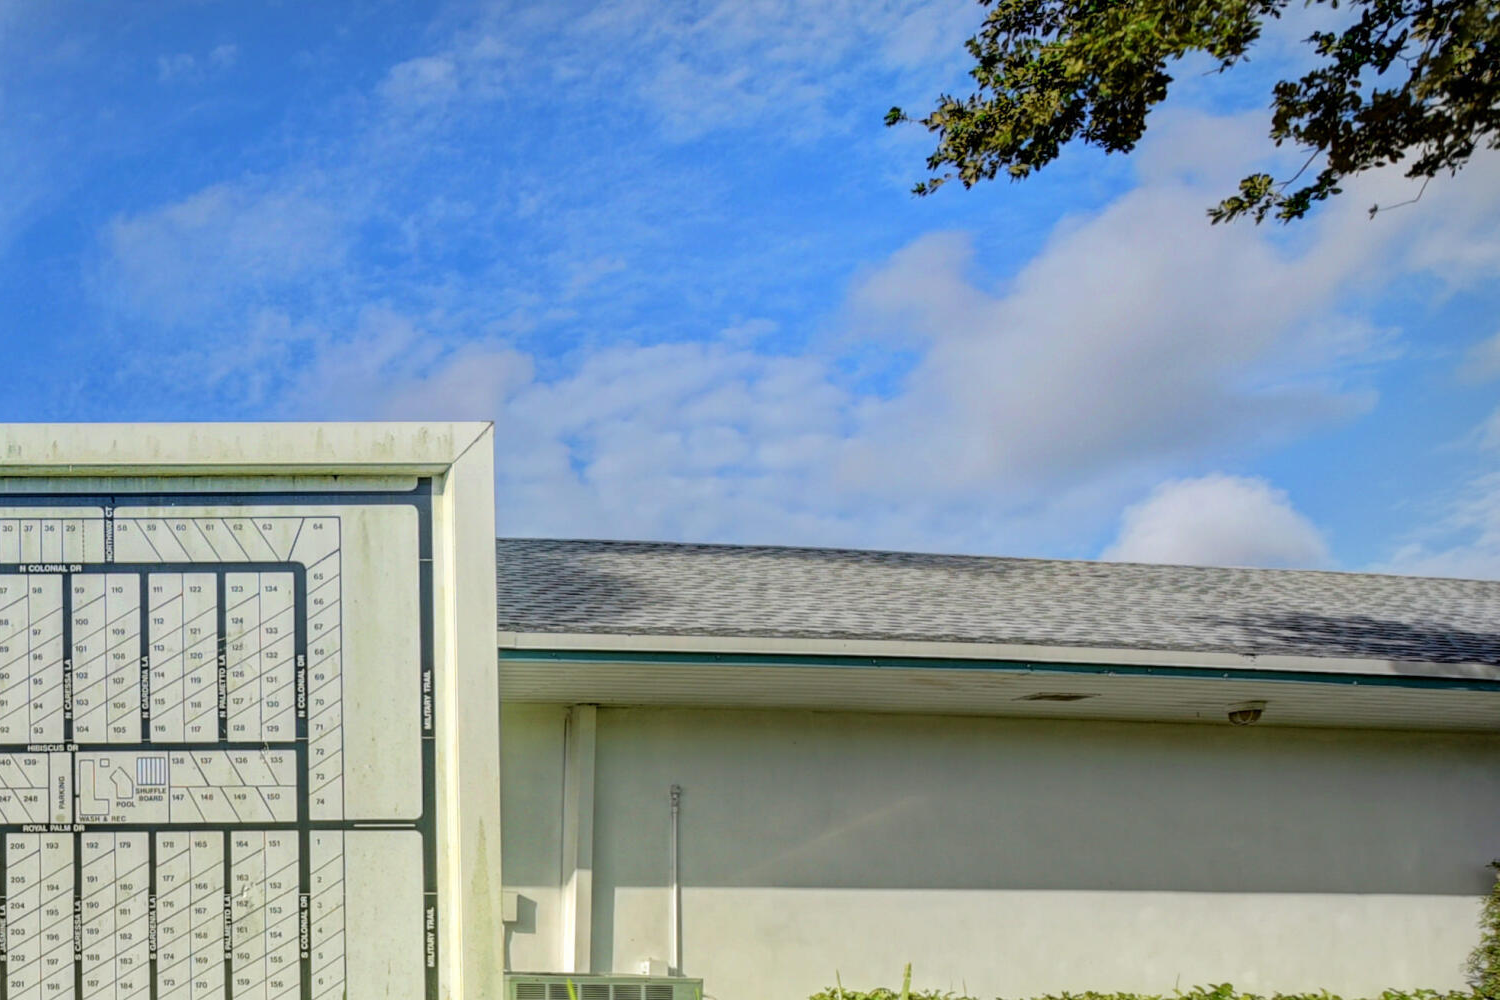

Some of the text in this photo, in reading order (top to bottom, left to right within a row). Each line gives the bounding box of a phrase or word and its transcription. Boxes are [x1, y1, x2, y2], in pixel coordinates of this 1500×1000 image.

[105, 506, 113, 518] CT
[28, 564, 68, 572] COLONIAL
[70, 564, 82, 572] DR
[75, 618, 88, 626] 100
[75, 645, 87, 654] 101
[65, 659, 72, 671] LA
[219, 654, 226, 666] LA
[0, 673, 10, 681] 90
[112, 677, 124, 685] 107
[141, 656, 149, 719] N GARDENIA LA
[297, 654, 305, 718] N COLONIAL DR
[0, 699, 8, 707] 91
[424, 669, 432, 730] MILITARY TRAIL
[27, 744, 79, 752] HIBISCUS DR
[316, 748, 324, 756] 72
[22, 824, 85, 832] ROYAL PALM DR
[86, 875, 98, 883] 191
[74, 900, 81, 912] LA
[149, 897, 156, 909] LA
[224, 896, 231, 907] LA
[301, 896, 308, 908] DR
[0, 904, 6, 916] LA
[426, 906, 434, 968] MILITARY TRAIL
[301, 951, 308, 959] S
